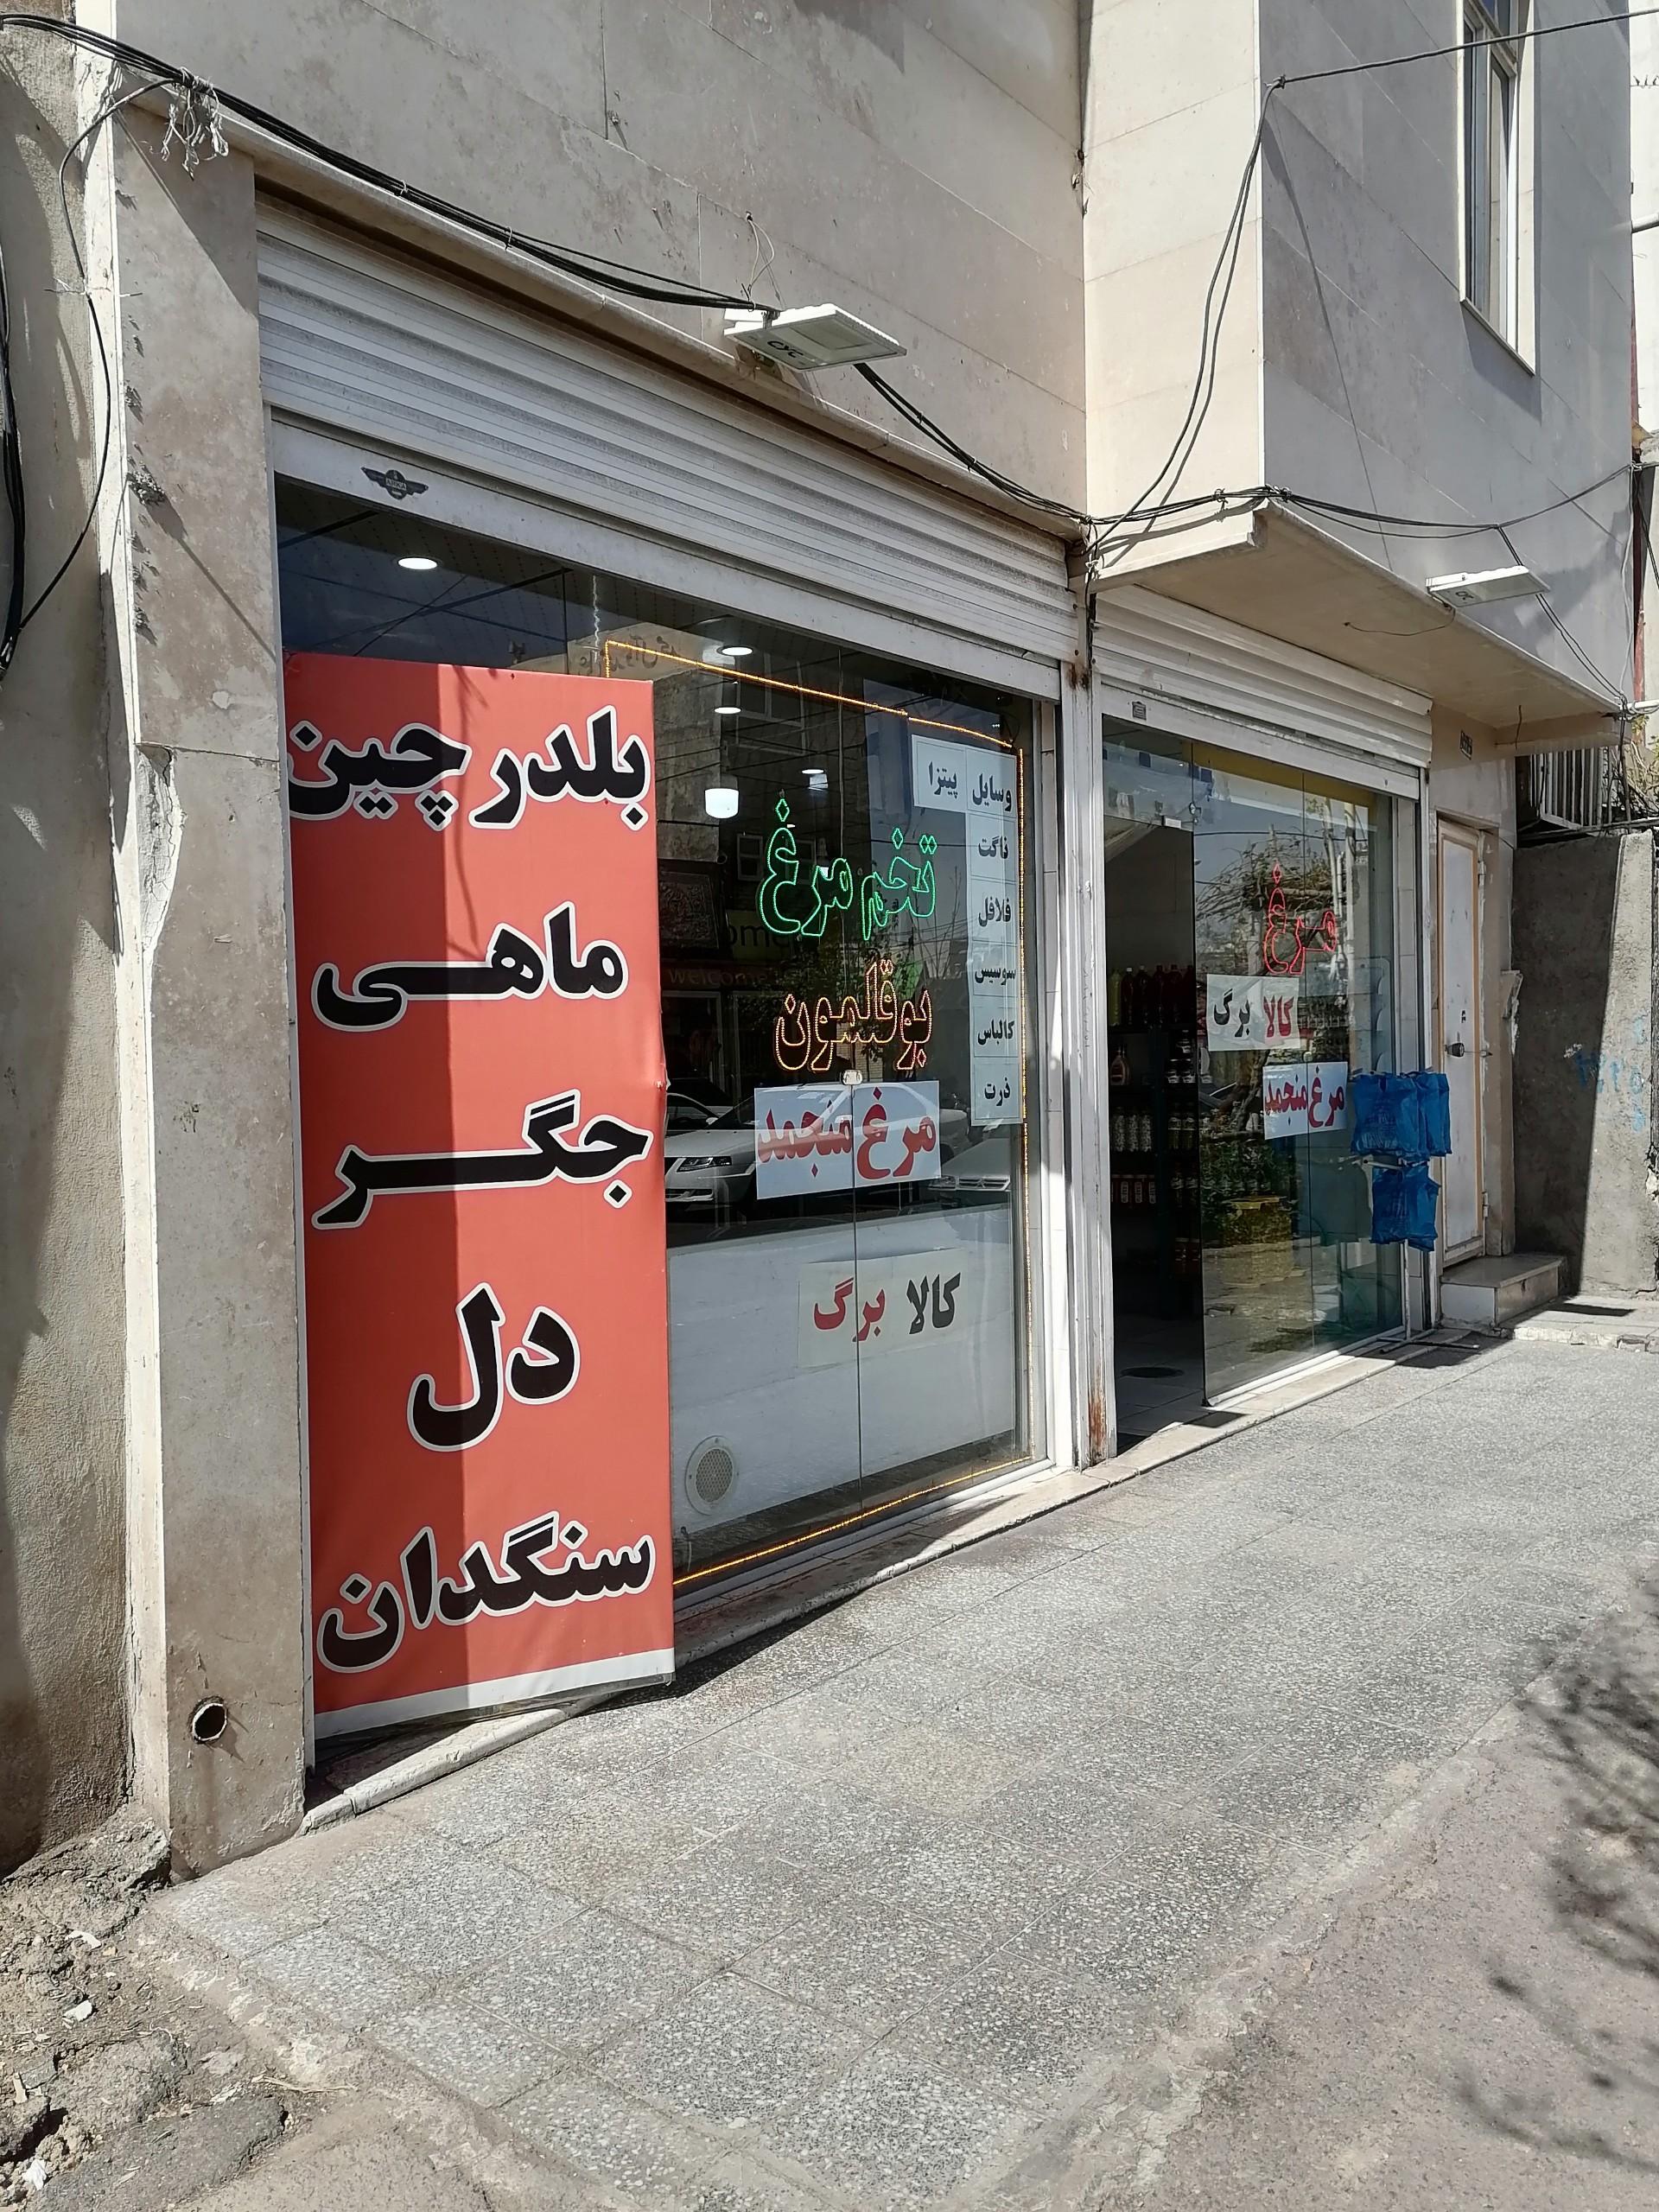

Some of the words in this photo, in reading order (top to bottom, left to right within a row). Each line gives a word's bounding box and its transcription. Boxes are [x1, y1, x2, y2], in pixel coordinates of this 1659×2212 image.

[286, 704, 652, 830] بلدرچین
[928, 760, 958, 798] پیتزا
[972, 773, 1013, 812] وسایل
[760, 798, 854, 937] مرغ
[977, 835, 1009, 860] ناگت
[861, 827, 938, 941] تخم
[977, 895, 1012, 927] فلافل
[1263, 862, 1338, 975] مرغ
[312, 901, 628, 1032] ماهی
[975, 966, 1017, 986] سوسیس
[775, 958, 932, 1071] بوقلمون
[977, 1019, 1015, 1046] کالباس
[1213, 988, 1251, 1038] برگ
[1262, 995, 1295, 1038] کالا
[984, 1077, 1011, 1108] ذرت
[1264, 1073, 1308, 1126] منجمد
[1308, 1065, 1345, 1128] مرغ
[311, 1089, 654, 1230] جگر
[757, 1098, 853, 1179] منجمد
[856, 1086, 937, 1180] مرغ
[813, 1276, 887, 1343] برگ
[906, 1271, 962, 1335] کالا
[407, 1281, 581, 1452] دل
[316, 1510, 655, 1672] سنگدان
